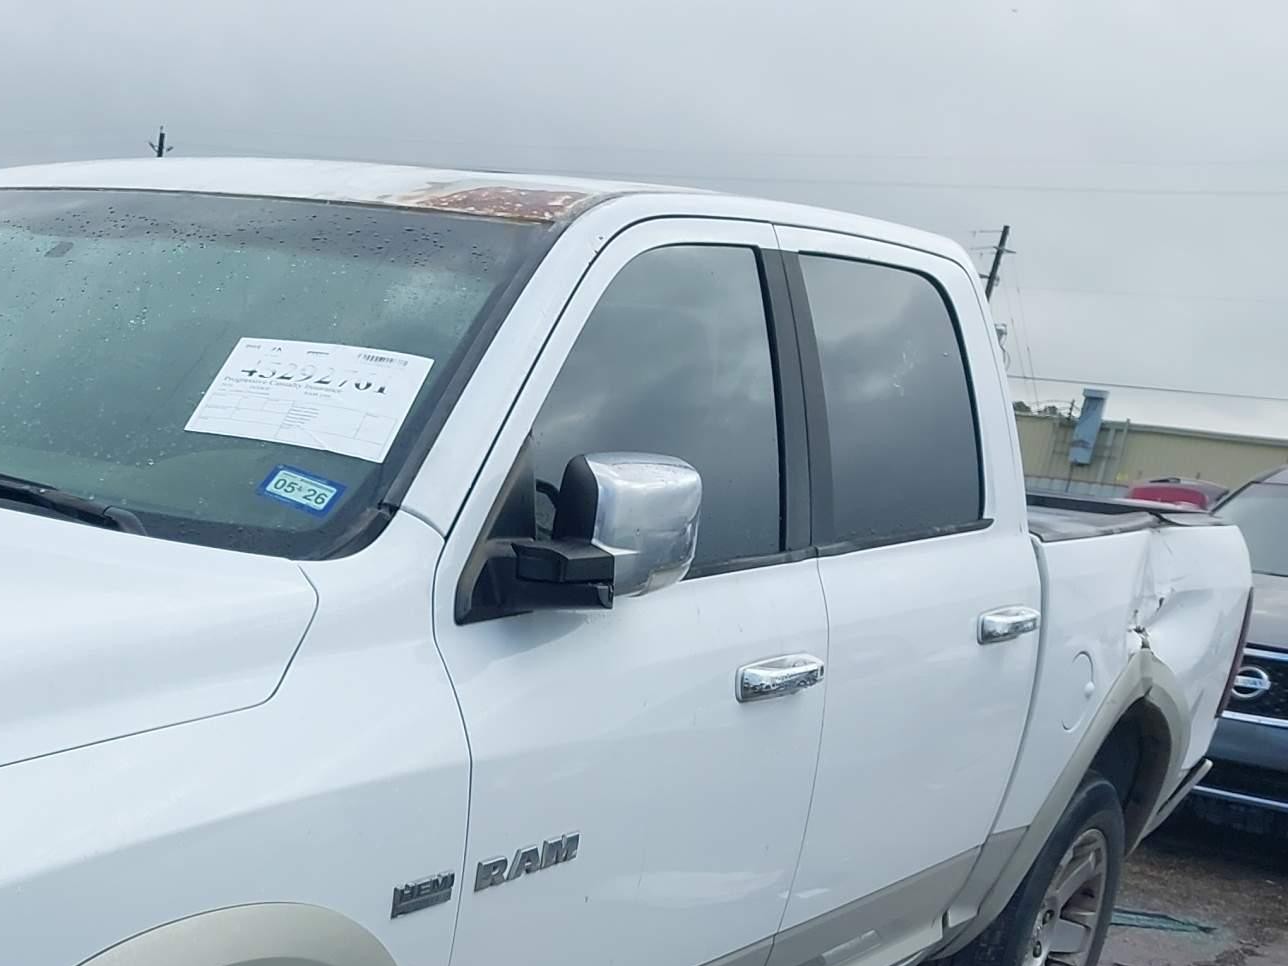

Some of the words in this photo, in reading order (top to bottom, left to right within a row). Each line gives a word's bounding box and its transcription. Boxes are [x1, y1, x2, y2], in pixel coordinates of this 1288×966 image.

[274, 478, 298, 494] 05
[302, 488, 328, 505] 26
[474, 832, 579, 892] RAM
